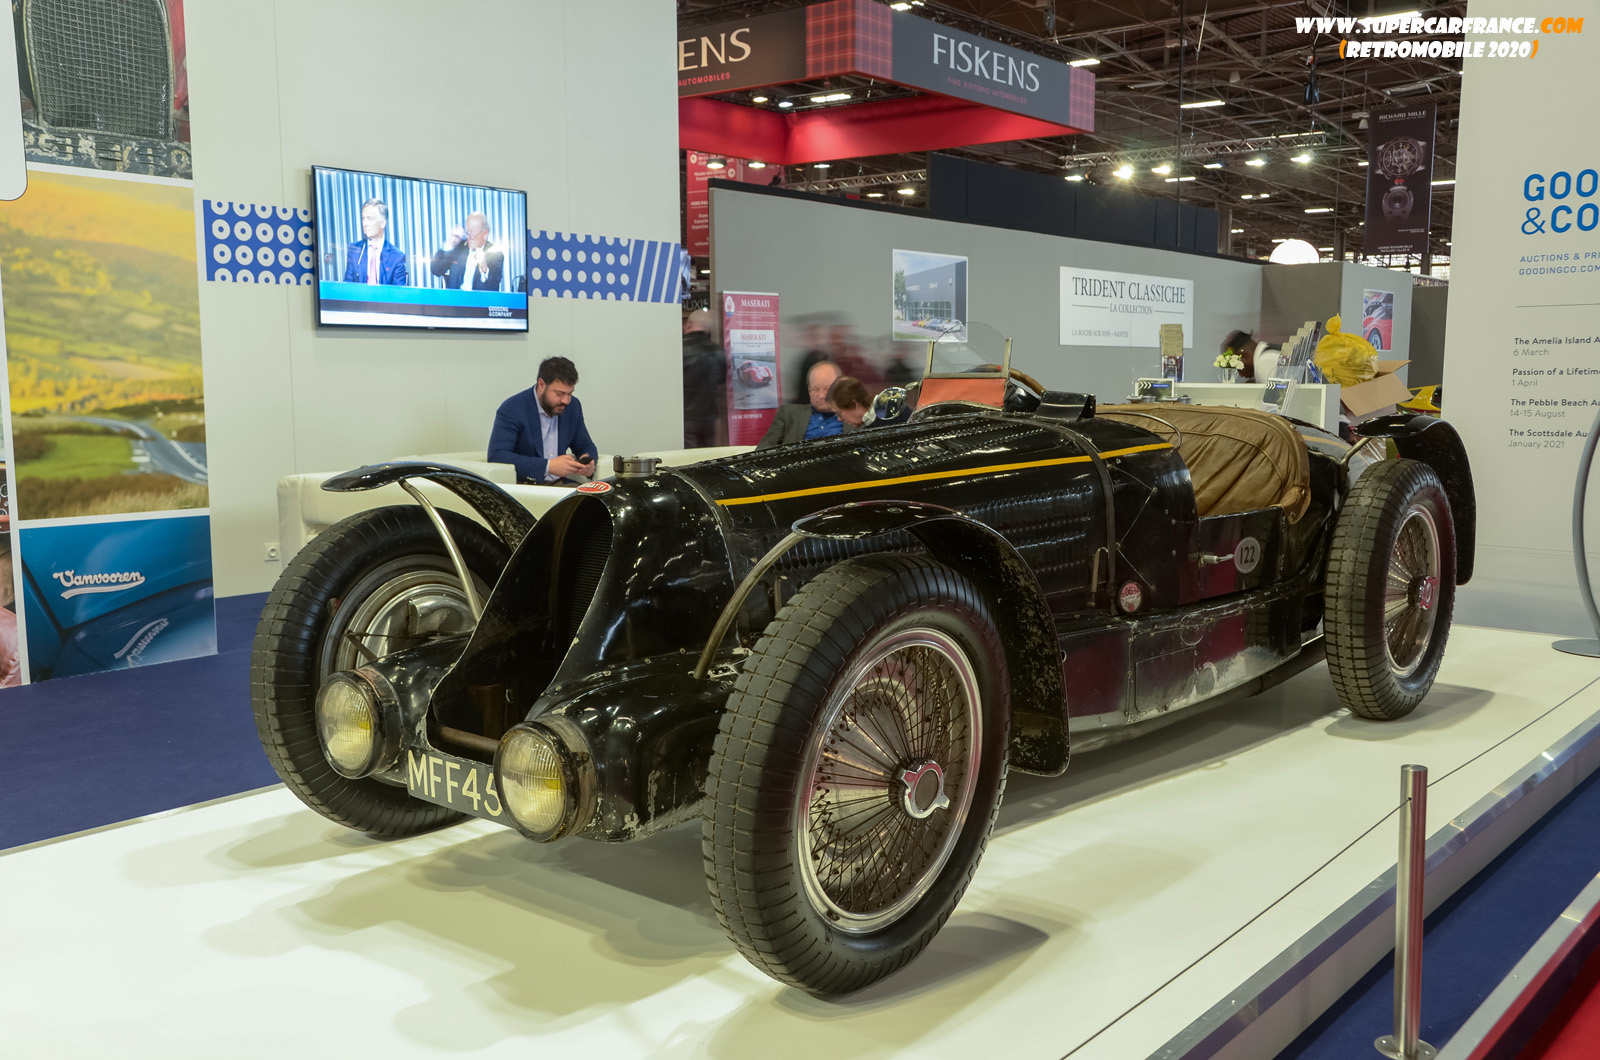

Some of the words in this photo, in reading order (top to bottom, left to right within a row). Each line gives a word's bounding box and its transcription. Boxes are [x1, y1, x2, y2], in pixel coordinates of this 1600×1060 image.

[933, 33, 1040, 92] FISKENS
[678, 72, 731, 87] AUTOMOBILES
[1379, 112, 1406, 120] RICHARD
[1524, 169, 1599, 202] GOO
[1520, 253, 1569, 263] AUCTIONS
[1573, 252, 1580, 260] &
[1519, 264, 1600, 276] GOODINGCO.COM
[1072, 276, 1125, 299] TRIDENT
[1128, 281, 1186, 304] CLASSICHE
[741, 299, 770, 308] MASERATI
[1109, 303, 1118, 313] LA
[1118, 303, 1153, 315] COLLECTION
[1514, 337, 1530, 345] The
[1532, 336, 1562, 345] Amelia
[1565, 336, 1591, 344] Island
[1513, 348, 1519, 356] 6
[1522, 348, 1549, 356] March
[1512, 368, 1544, 376] Passion
[1547, 367, 1557, 376] of
[1517, 379, 1538, 388] April
[1511, 398, 1526, 406] The
[1529, 398, 1558, 407] Pebble
[1561, 398, 1588, 407] Beach
[1510, 409, 1533, 417] 14-15
[1534, 410, 1566, 419] August
[1509, 428, 1525, 437] The
[1527, 429, 1573, 438] Scottsdale
[1508, 440, 1541, 449] January
[1543, 440, 1565, 448] 2021
[1240, 545, 1255, 564] 122
[52, 569, 145, 590] Vanvooren
